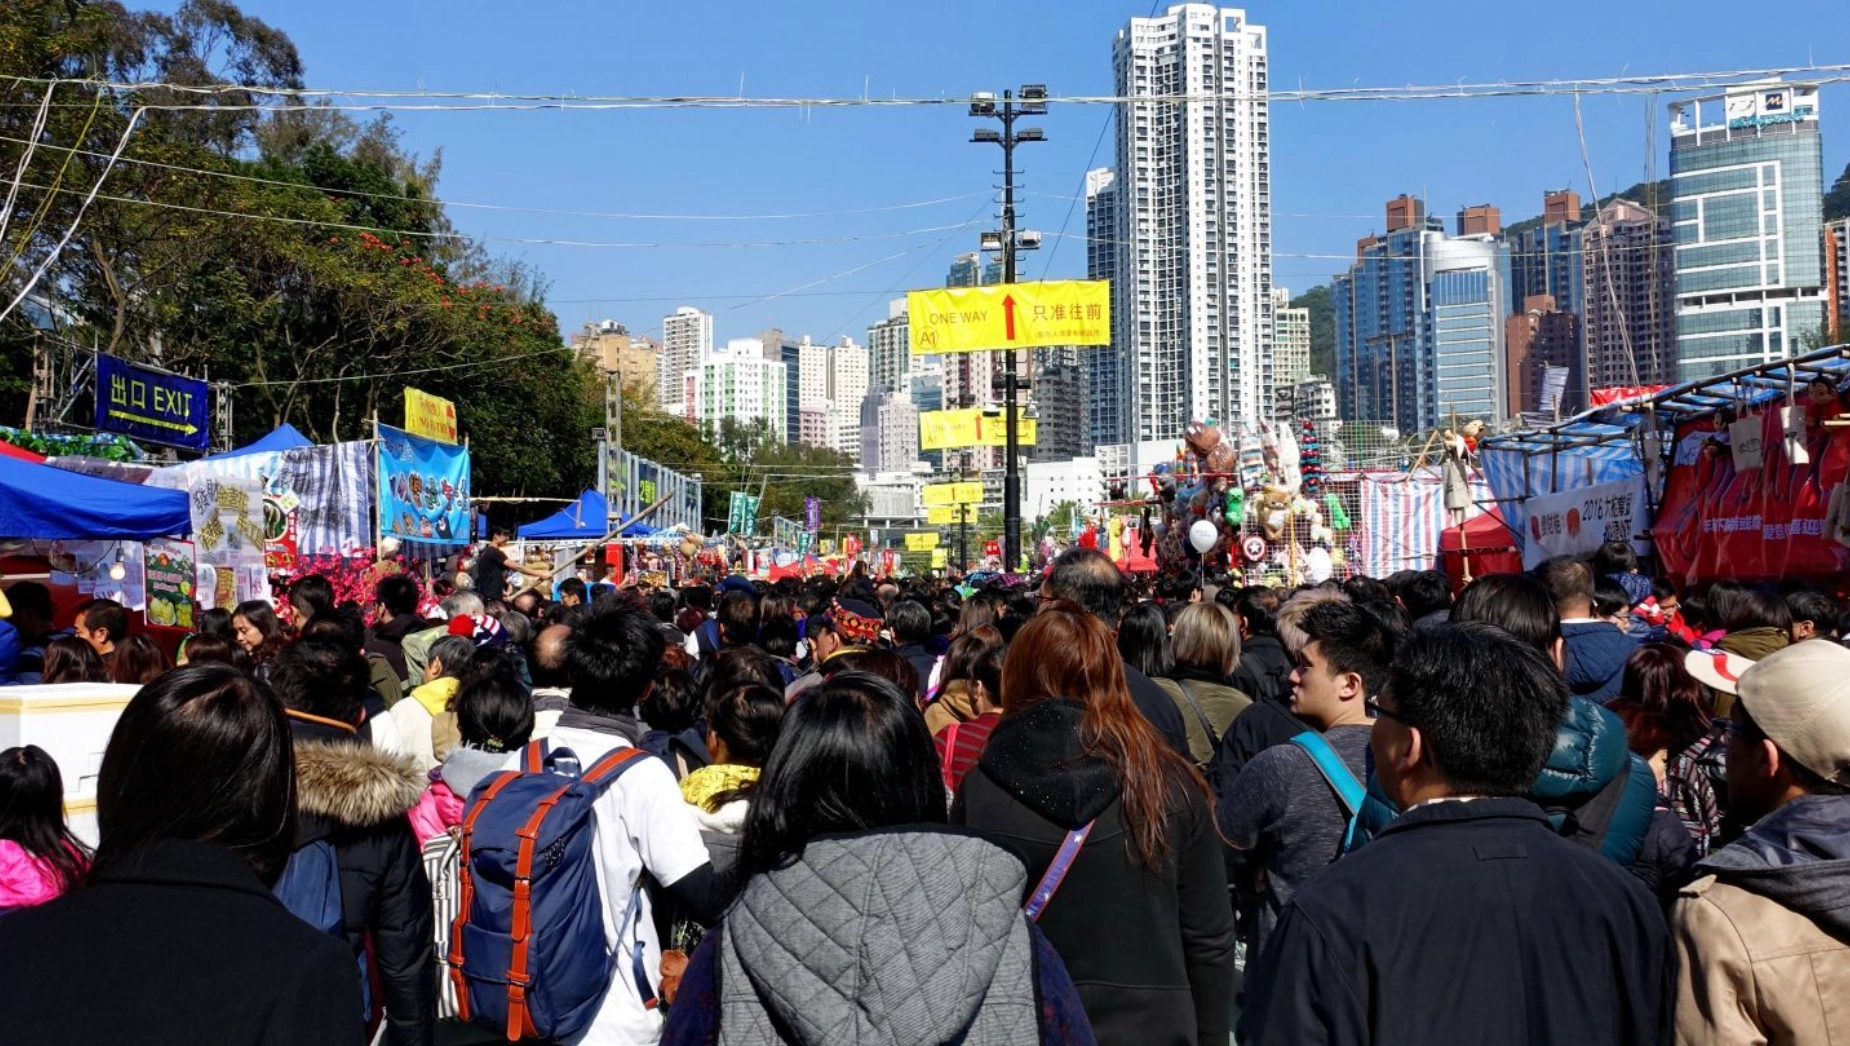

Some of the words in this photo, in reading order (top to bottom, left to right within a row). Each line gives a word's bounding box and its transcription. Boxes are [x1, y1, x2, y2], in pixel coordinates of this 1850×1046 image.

[930, 312, 957, 326] ONE
[959, 310, 988, 323] WAY
[1032, 303, 1103, 323] 只准往前
[919, 331, 937, 346] A1
[111, 374, 147, 410] 出口
[153, 386, 193, 418] EXIT
[1582, 499, 1604, 521] 2016
